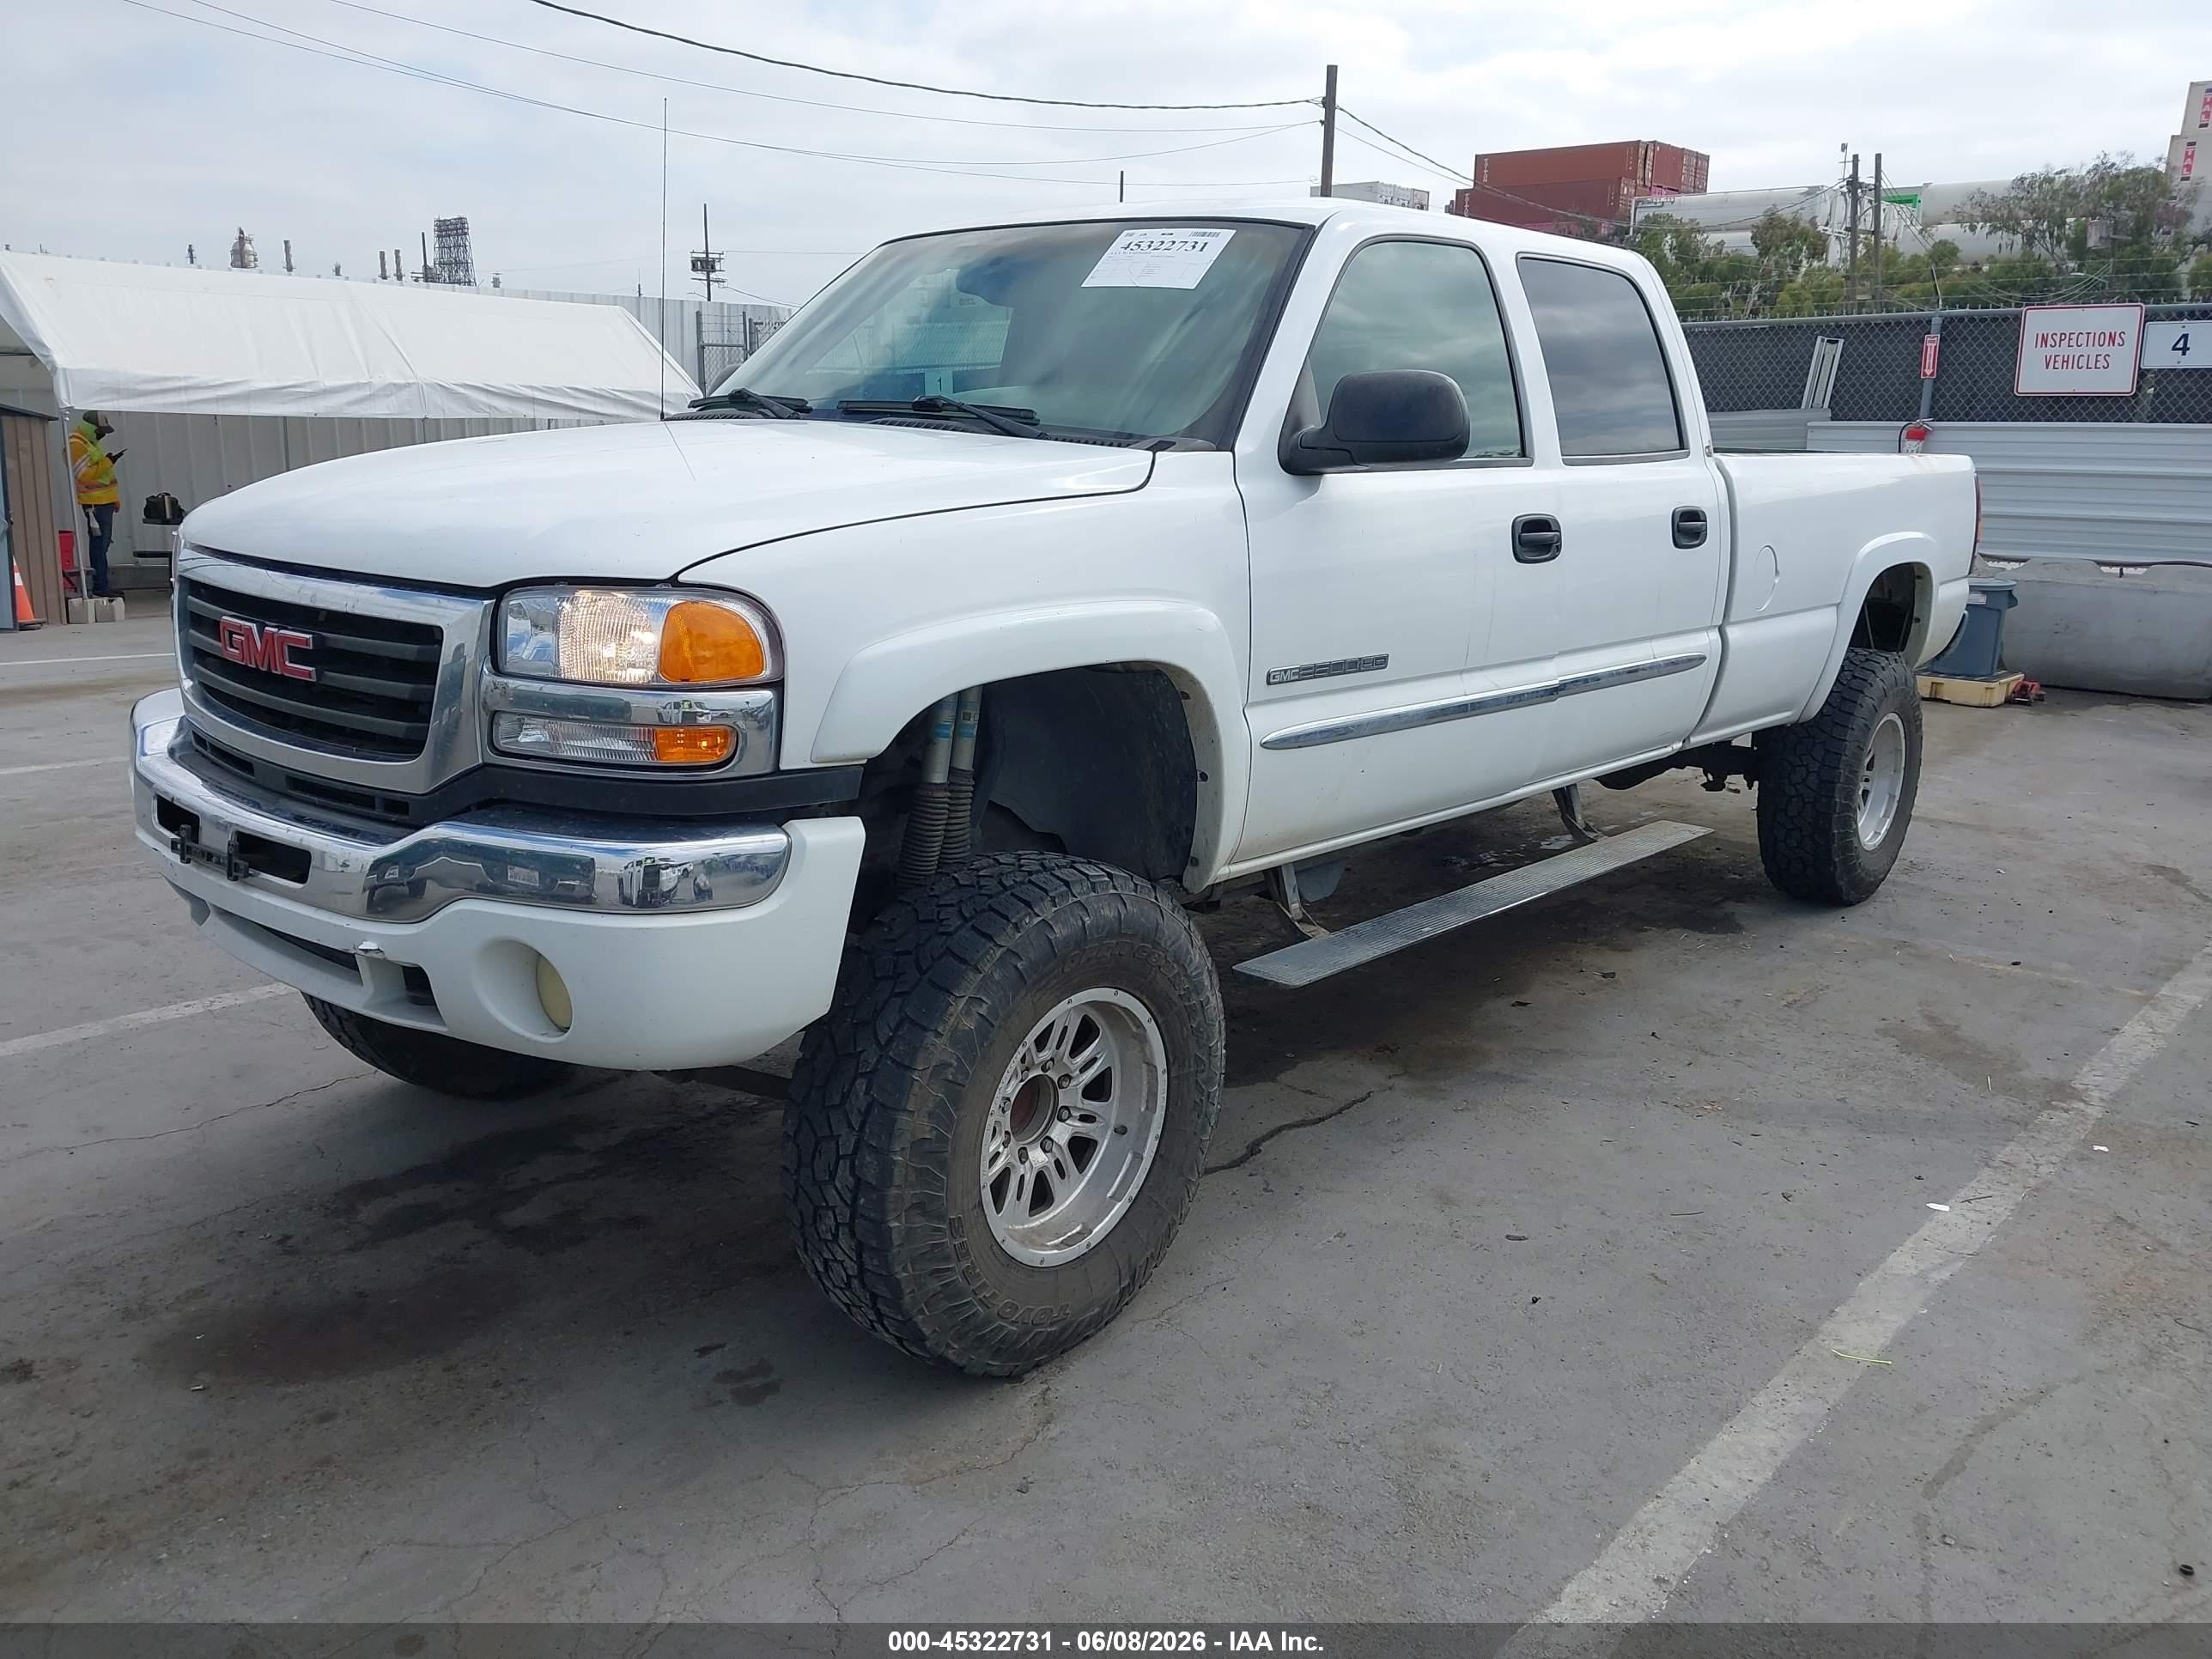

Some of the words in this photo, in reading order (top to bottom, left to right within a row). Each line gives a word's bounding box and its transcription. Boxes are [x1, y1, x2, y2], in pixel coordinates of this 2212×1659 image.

[1120, 240, 1209, 252] 45322731
[2034, 331, 2126, 349] INSPECTIONS
[2171, 332, 2191, 356] 4
[2045, 354, 2112, 370] VEHICLES
[220, 616, 317, 682] GMC
[1270, 668, 1300, 683] GMC
